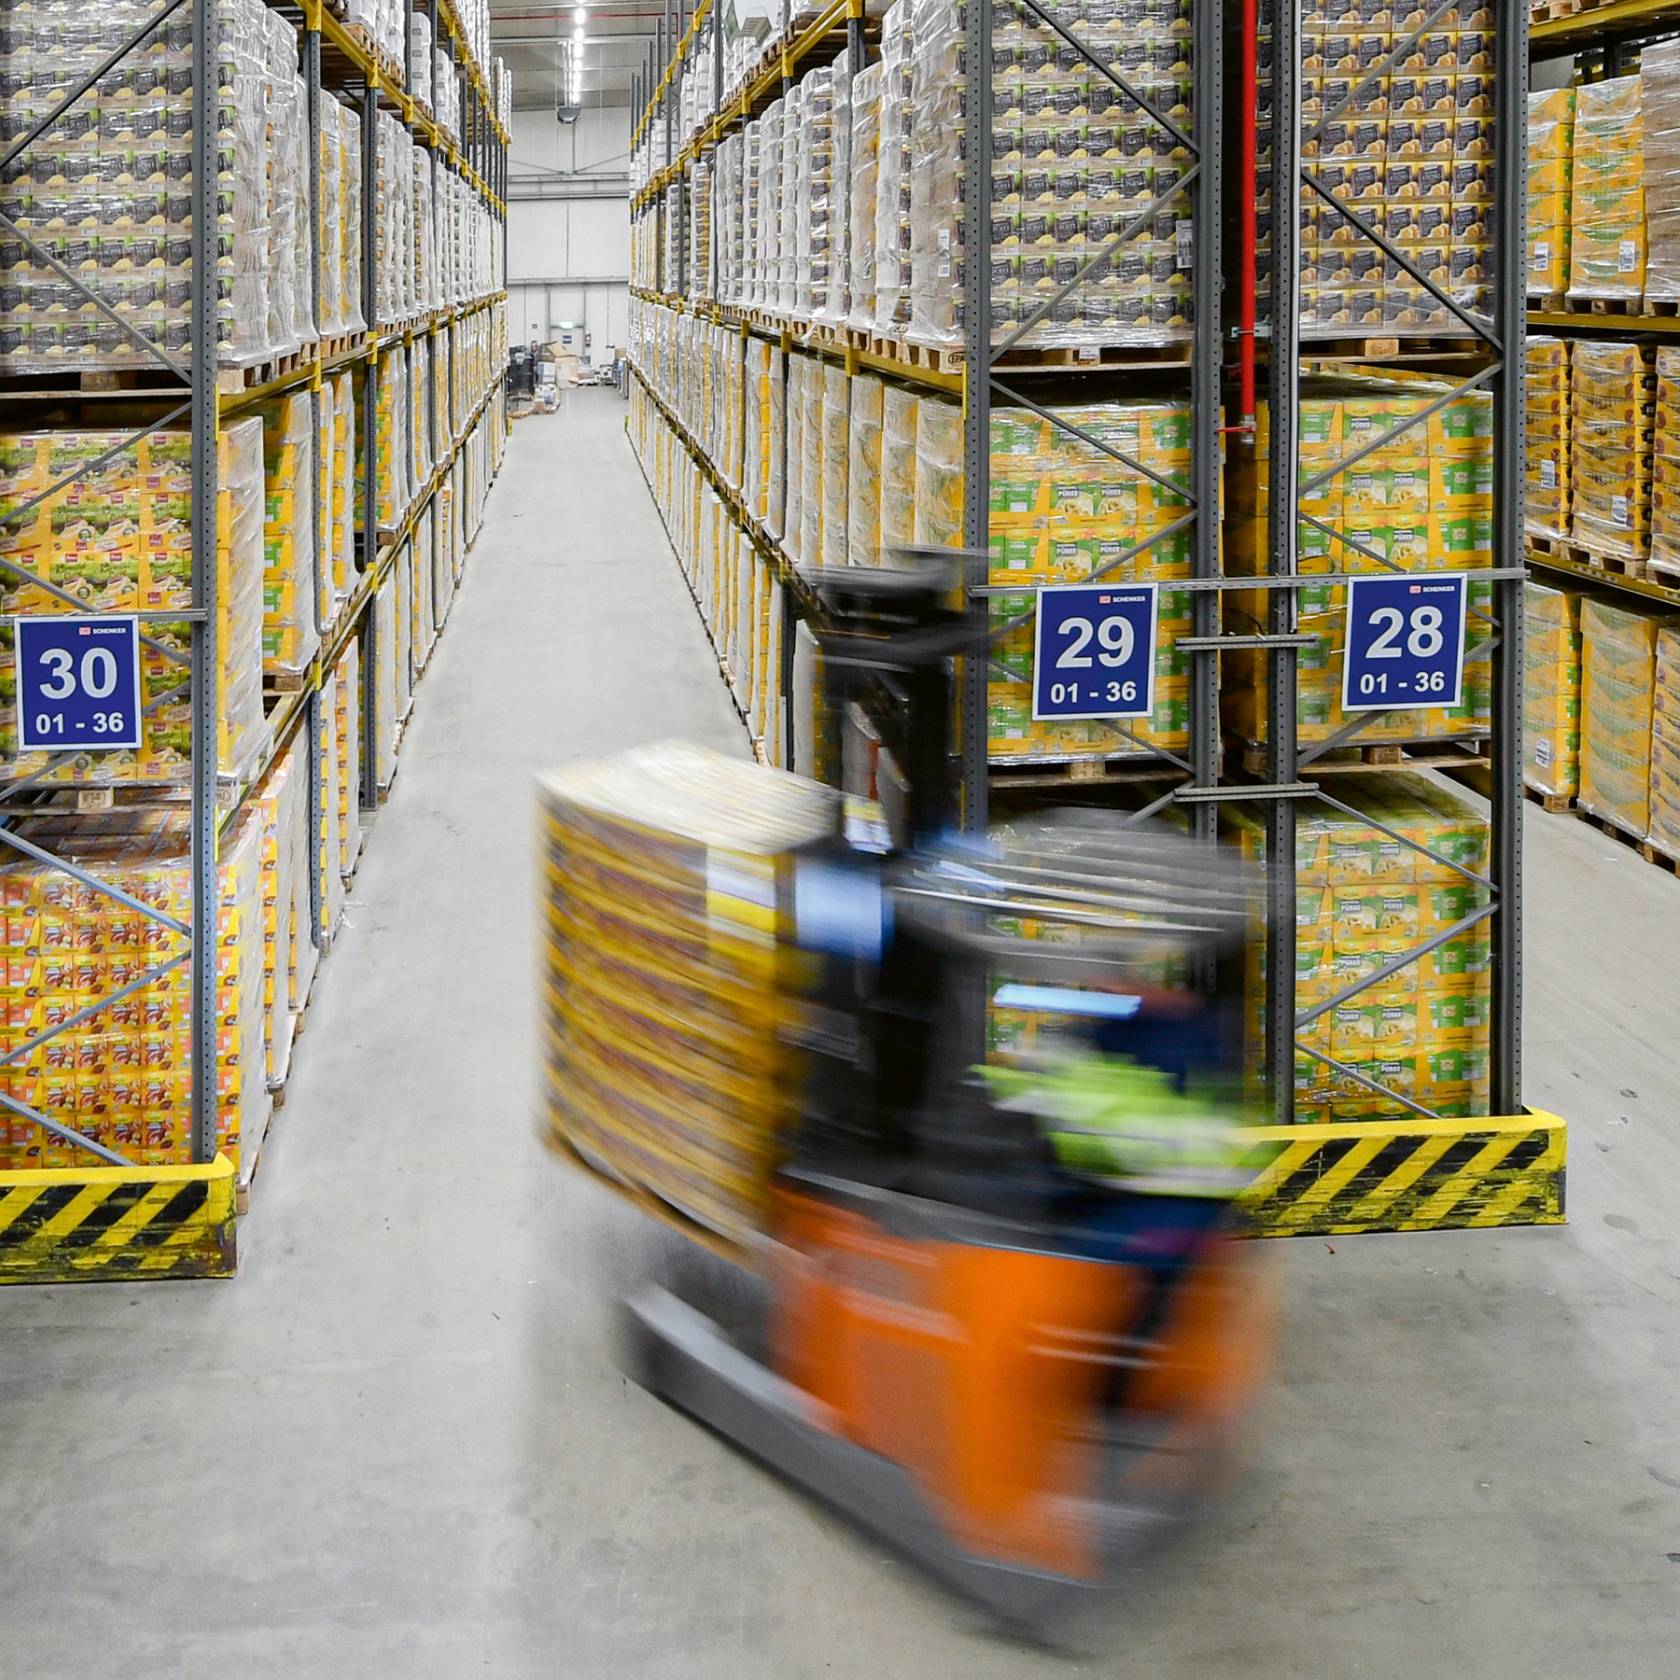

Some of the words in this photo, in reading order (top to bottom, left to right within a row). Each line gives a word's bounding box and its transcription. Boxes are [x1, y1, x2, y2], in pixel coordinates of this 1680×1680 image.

[1055, 615, 1135, 669] 29
[1365, 605, 1444, 659] 28
[39, 647, 118, 699] 30
[1050, 682, 1079, 704] 01
[1106, 680, 1137, 701] 36
[1360, 673, 1388, 694] 01
[1414, 671, 1445, 692] 36
[35, 713, 64, 734] 01
[92, 712, 124, 733] 36
